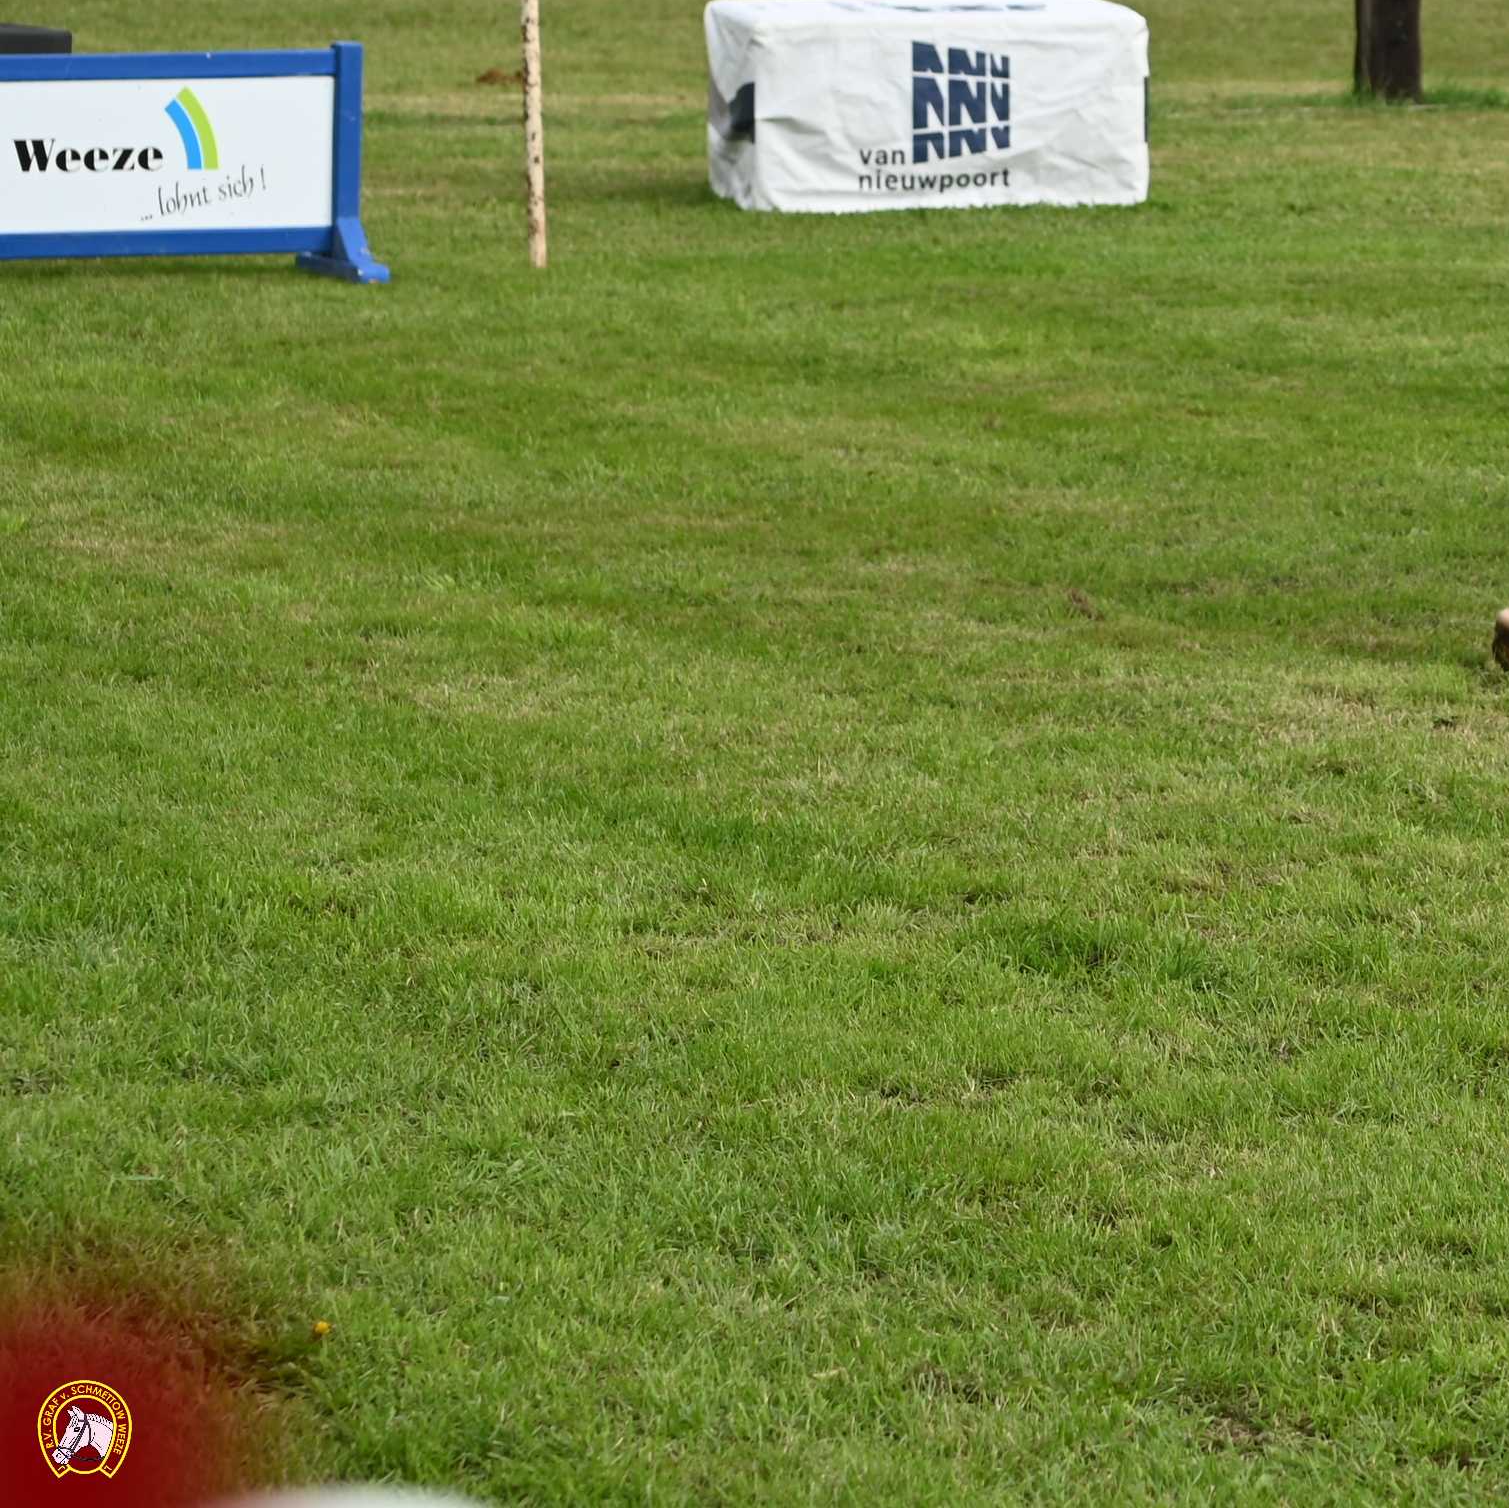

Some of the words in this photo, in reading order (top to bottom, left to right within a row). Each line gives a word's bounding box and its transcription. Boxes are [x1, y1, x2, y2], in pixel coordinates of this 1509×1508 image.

[13, 138, 165, 173] Weeze
[859, 147, 906, 166] van
[157, 183, 211, 217] lohnt
[217, 163, 255, 201] sich
[858, 168, 1011, 194] nieuwpoort
